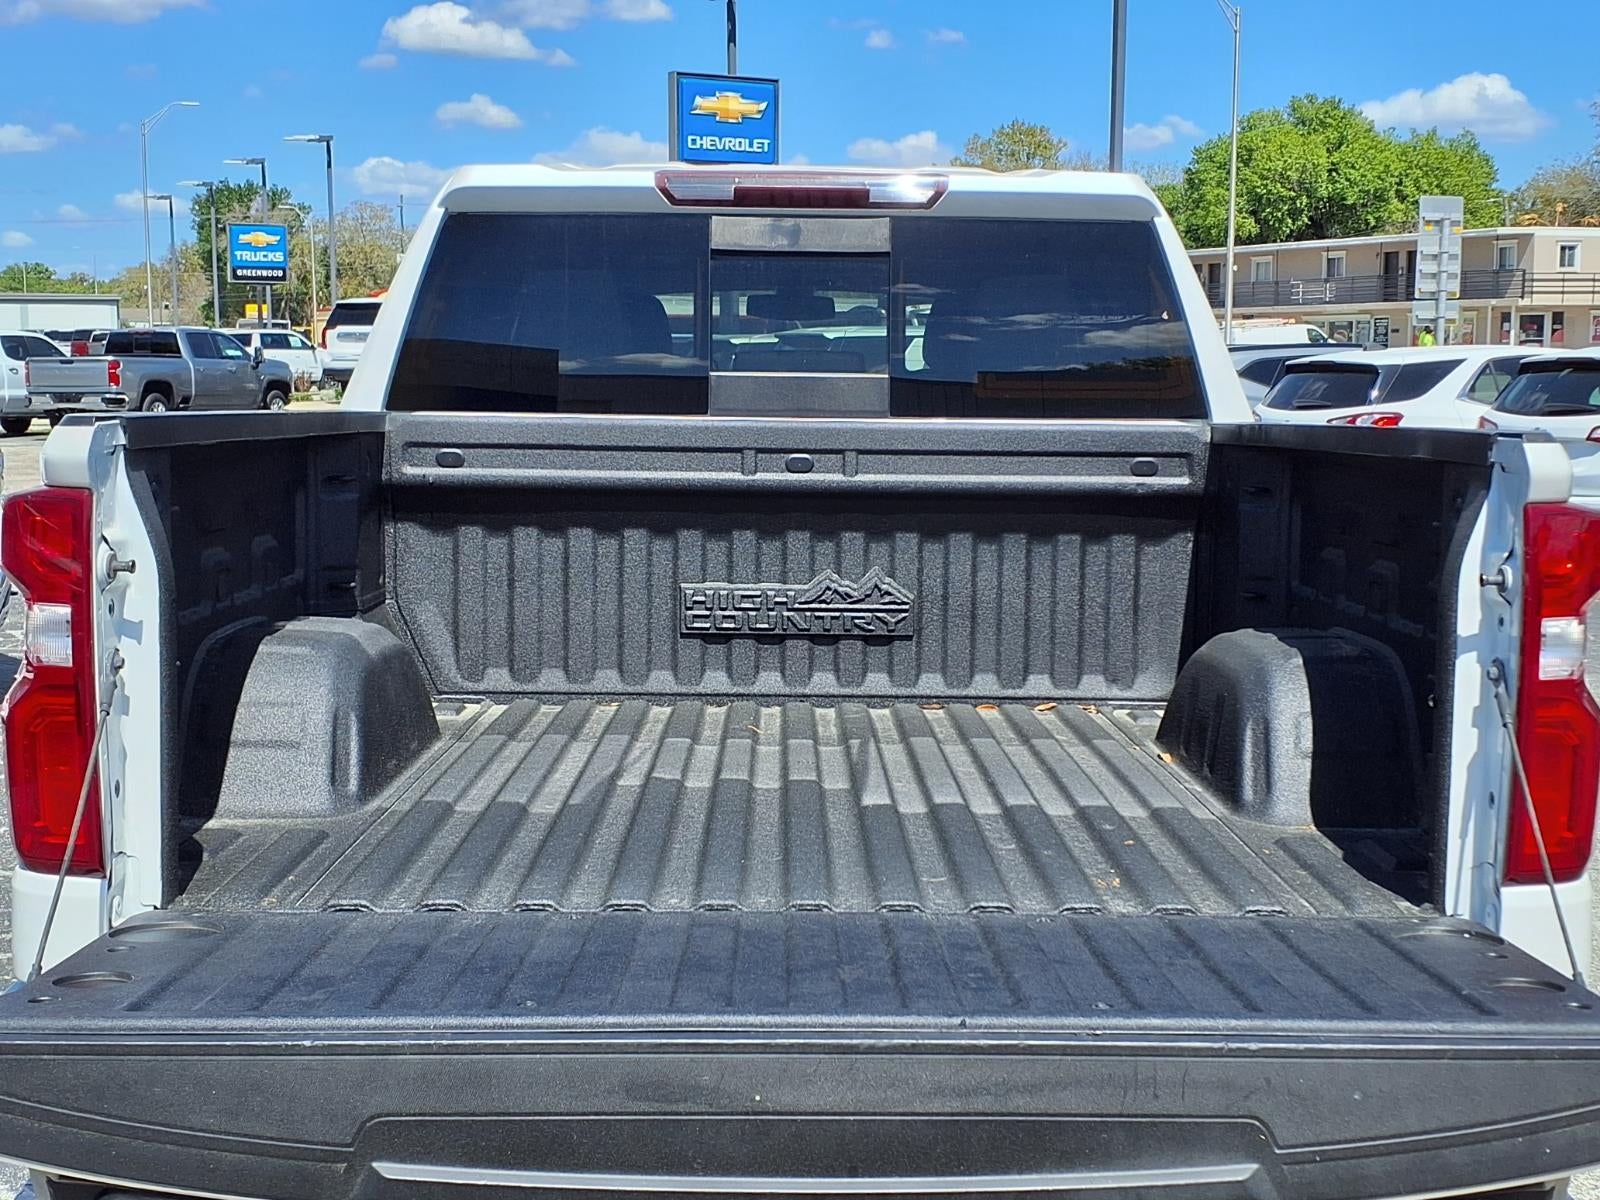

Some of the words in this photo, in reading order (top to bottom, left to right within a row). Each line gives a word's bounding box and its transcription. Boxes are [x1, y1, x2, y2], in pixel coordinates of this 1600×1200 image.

[687, 135, 771, 153] CHEVROLET
[234, 250, 284, 262] TRUCKS
[236, 269, 283, 277] GREENWOOD
[684, 590, 796, 608] HIGH
[684, 610, 910, 632] COUNTRY
